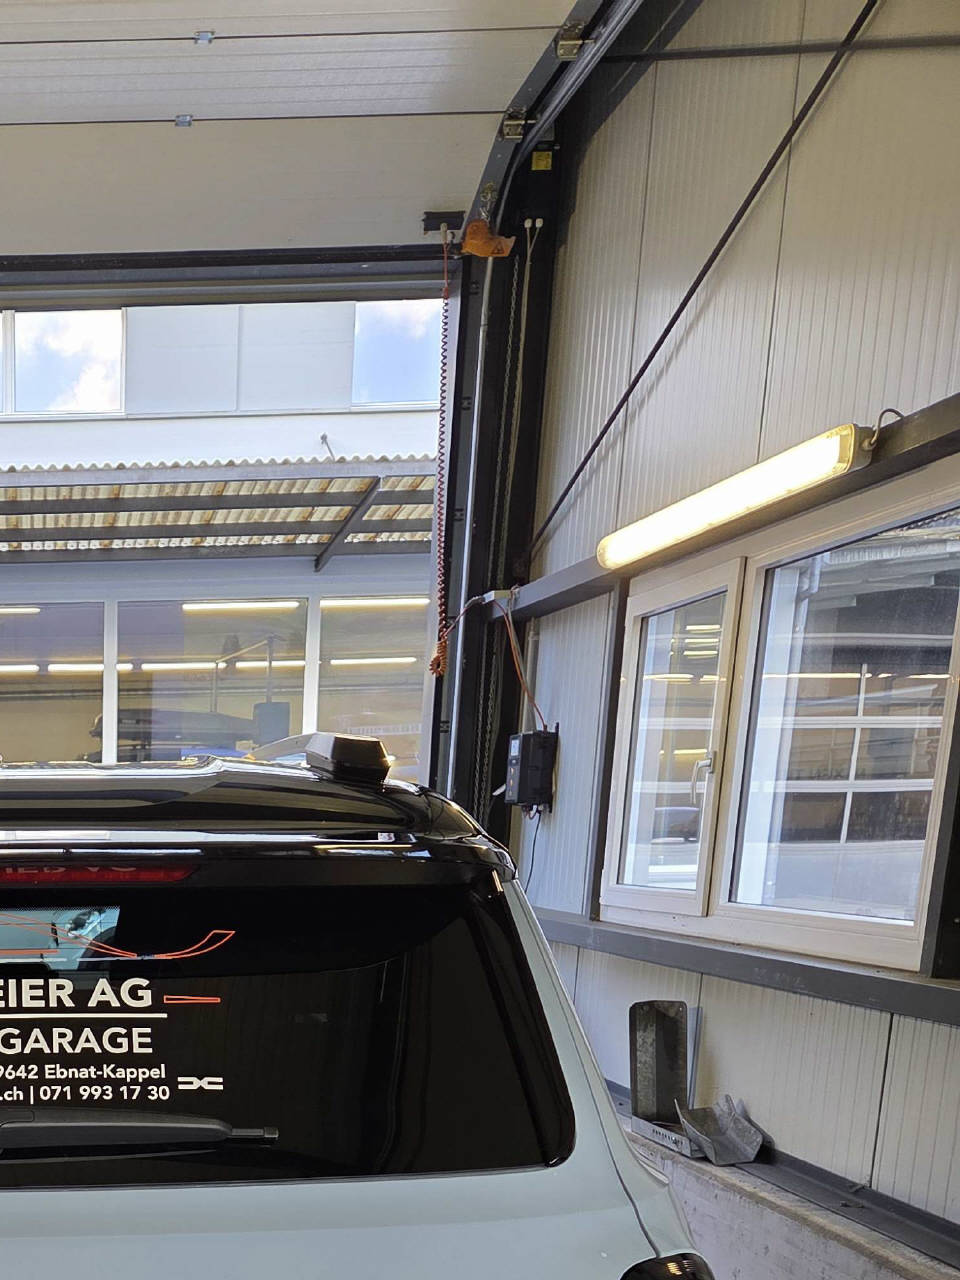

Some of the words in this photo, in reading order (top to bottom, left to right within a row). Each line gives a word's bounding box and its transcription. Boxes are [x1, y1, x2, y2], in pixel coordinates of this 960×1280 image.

[87, 978, 153, 1008] AG
[44, 1063, 166, 1083] Ebnat-Kappel
[39, 1085, 72, 1101] 071
[79, 1085, 113, 1100] 993
[119, 1085, 141, 1100] 17
[147, 1085, 170, 1100] 30
